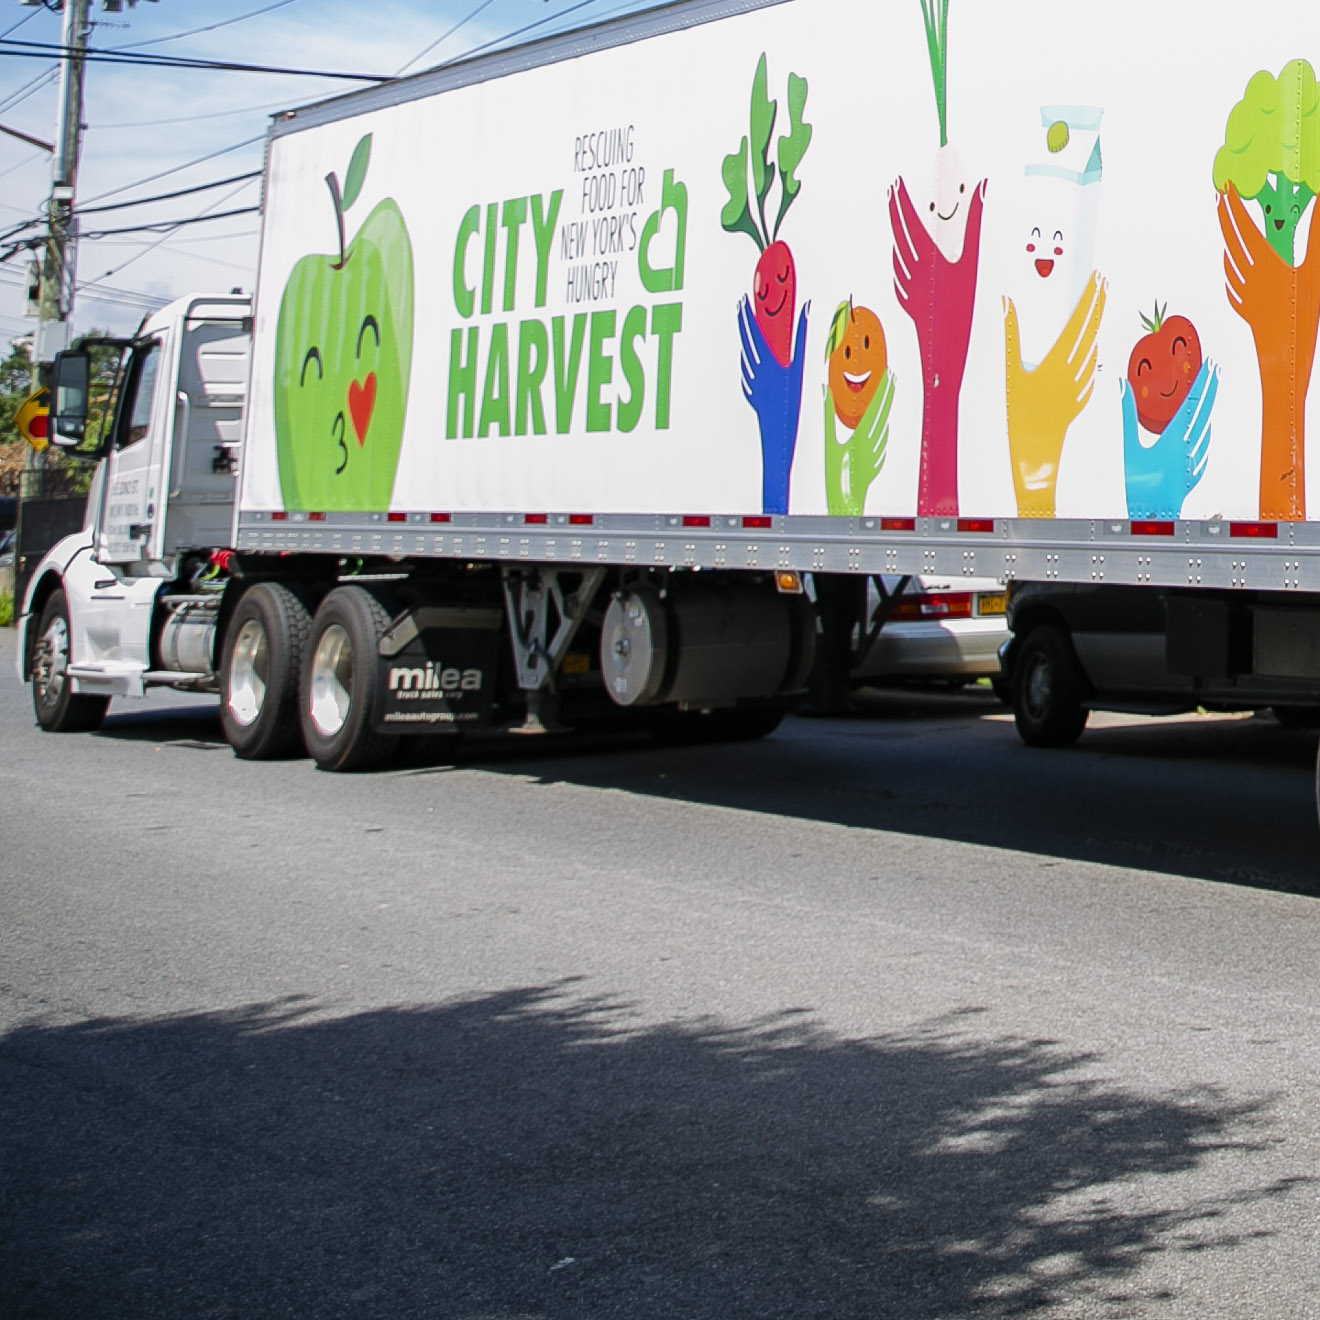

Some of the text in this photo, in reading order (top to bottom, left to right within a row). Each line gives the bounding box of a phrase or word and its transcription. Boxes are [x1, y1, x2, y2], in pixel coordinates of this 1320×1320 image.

[573, 124, 634, 174] RESCUING
[581, 167, 645, 214] FOOD FOR
[453, 189, 563, 319] CITY
[561, 212, 637, 261] NEW YORK'S
[566, 261, 617, 304] HUNGRY
[445, 302, 682, 440] HARVEST
[389, 661, 483, 690] milea
